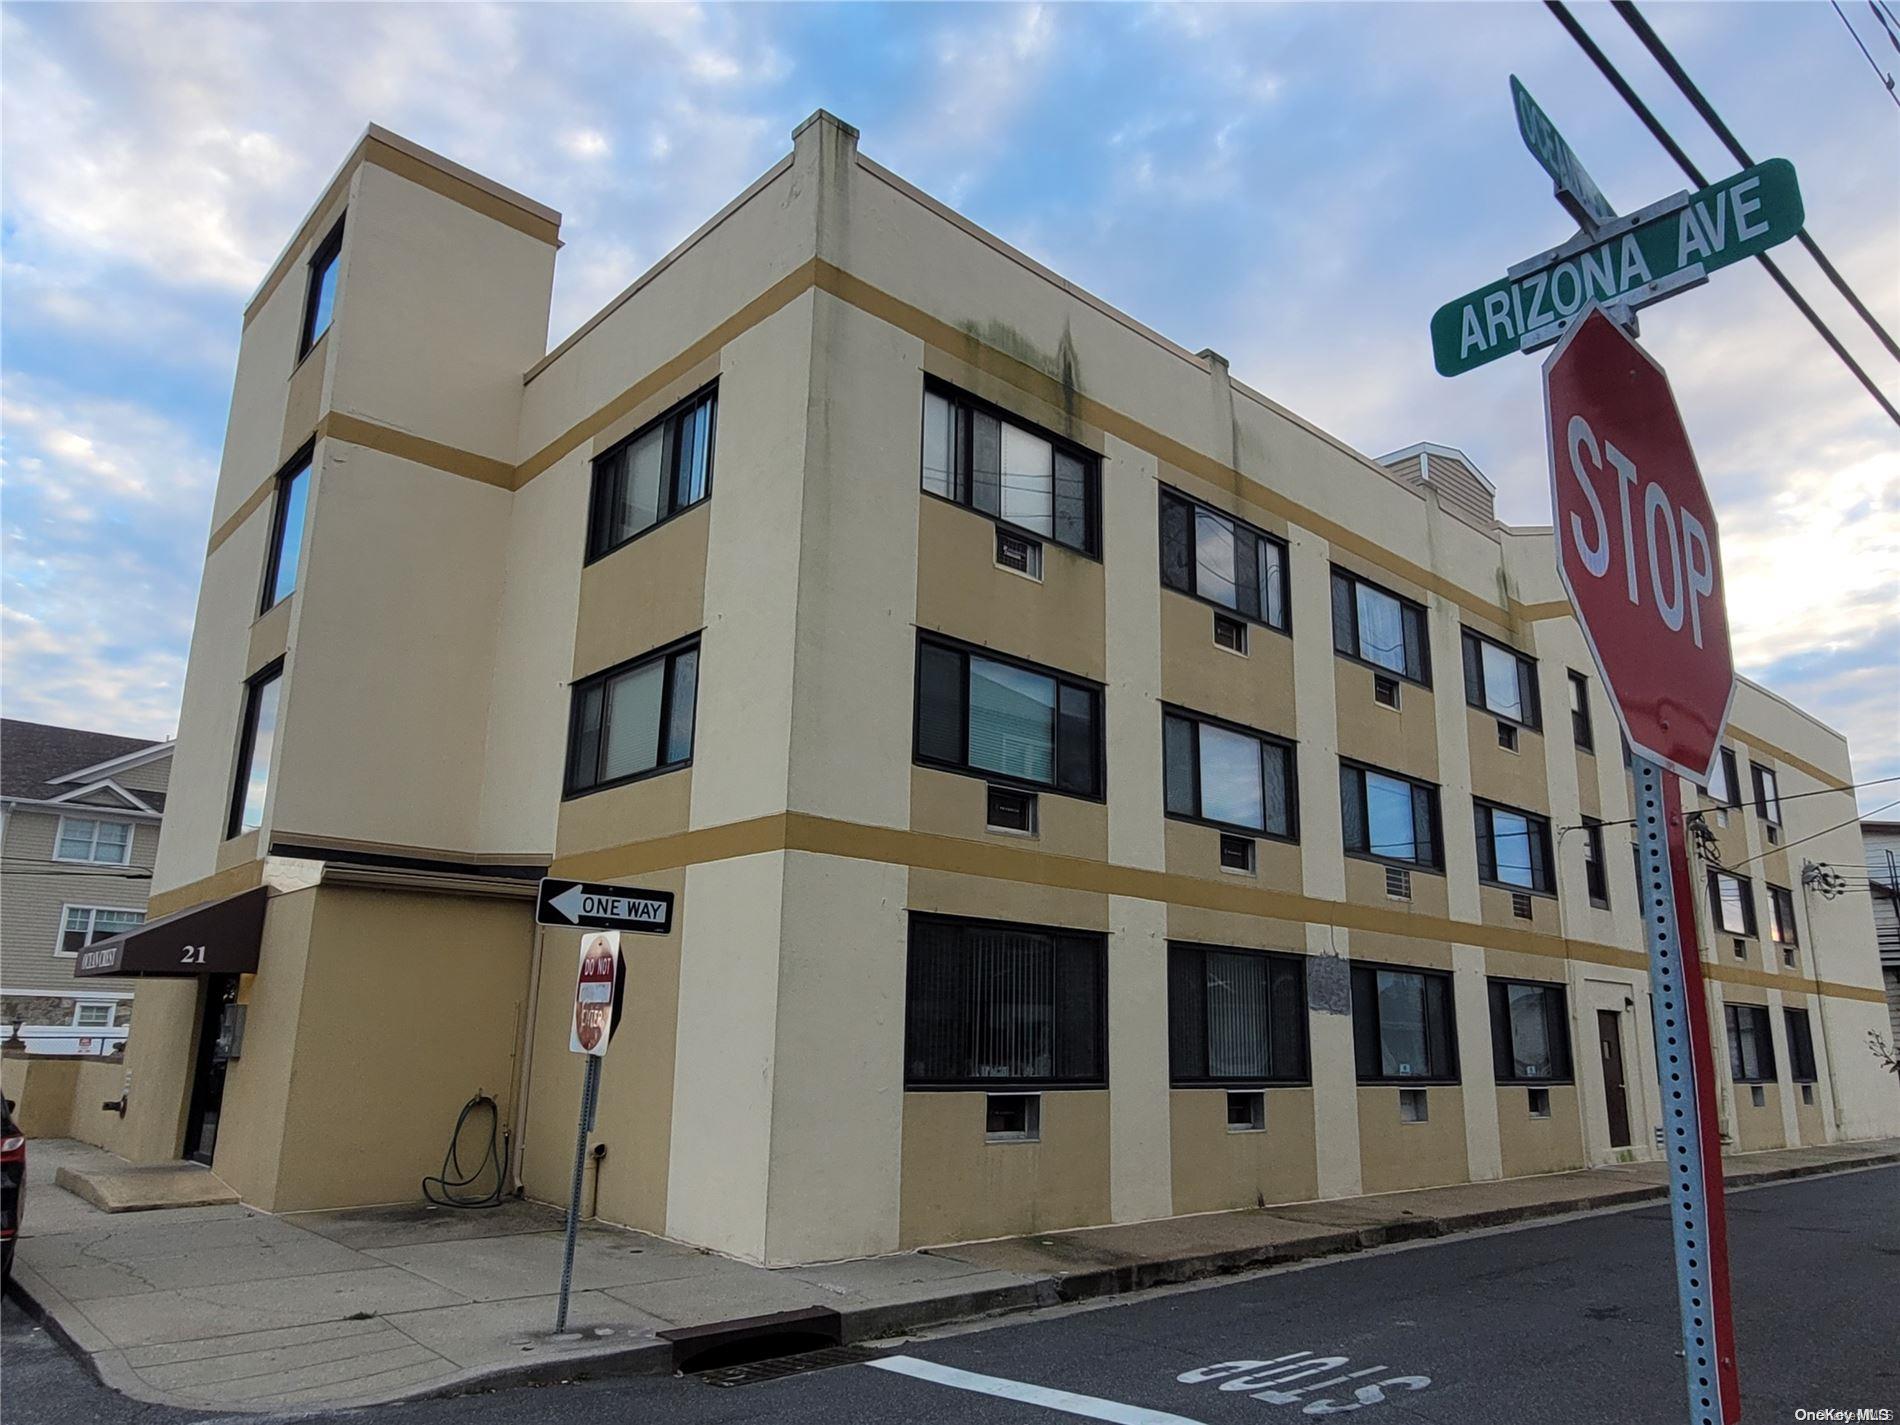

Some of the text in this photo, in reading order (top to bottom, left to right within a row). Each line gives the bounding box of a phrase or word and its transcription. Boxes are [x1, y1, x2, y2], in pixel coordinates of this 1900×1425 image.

[1460, 176, 1769, 360] ARIZONA AVE
[1567, 414, 1714, 650] STOP
[582, 896, 662, 920] ONE WAY
[180, 945, 206, 963] 21
[584, 957, 612, 976] DO NOT
[1177, 1351, 1431, 1414] STOP
